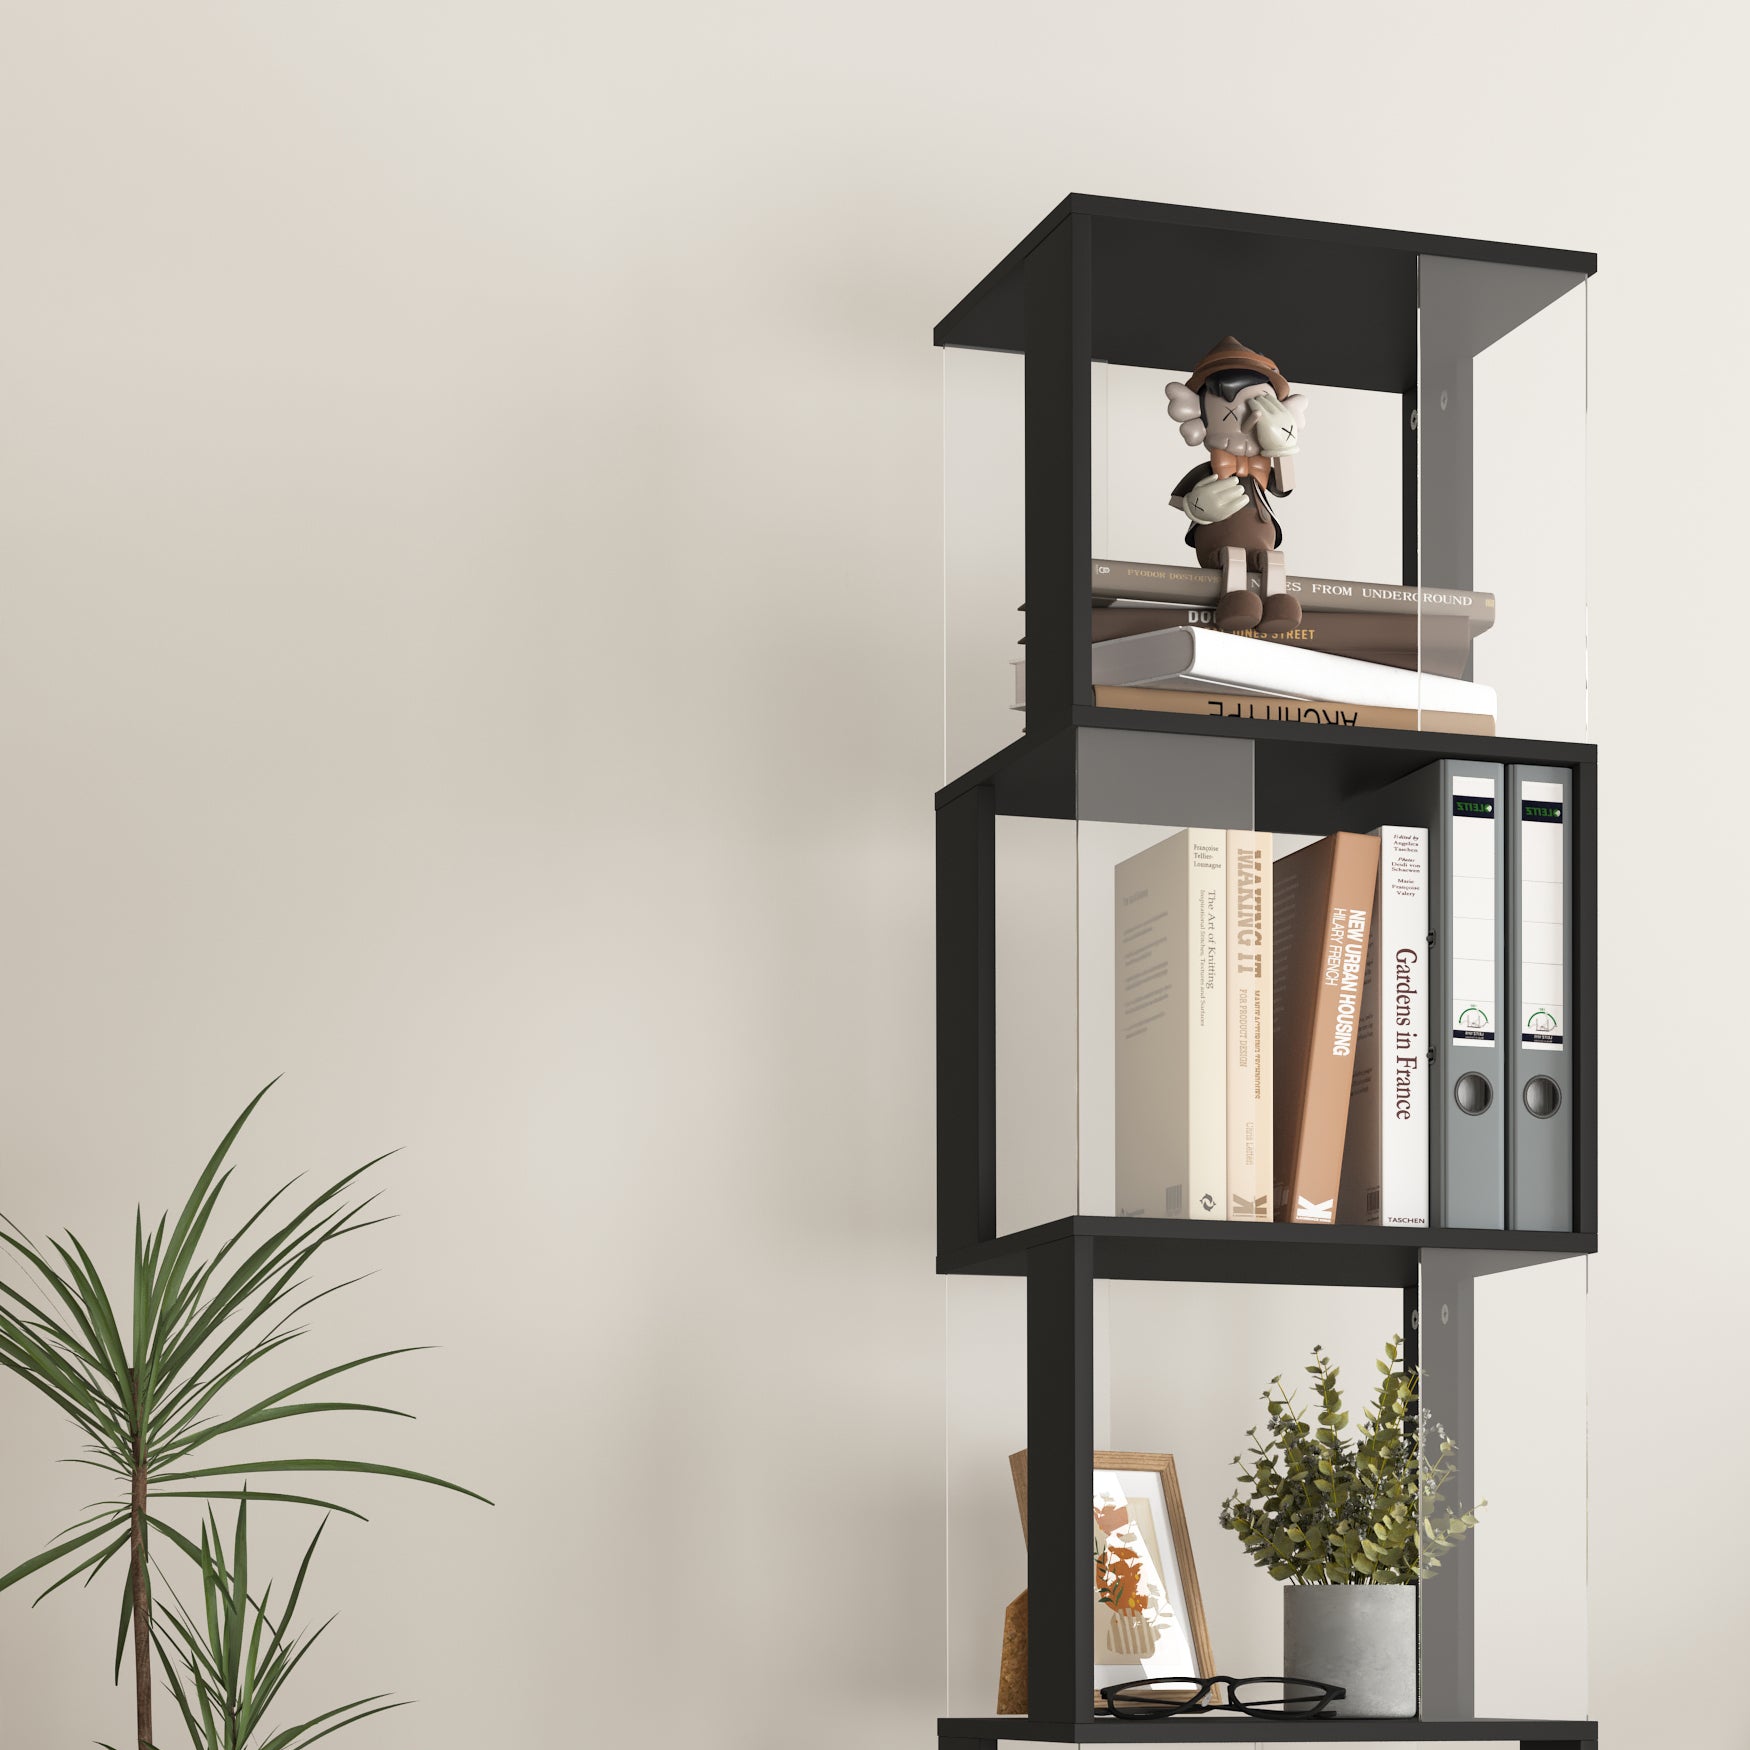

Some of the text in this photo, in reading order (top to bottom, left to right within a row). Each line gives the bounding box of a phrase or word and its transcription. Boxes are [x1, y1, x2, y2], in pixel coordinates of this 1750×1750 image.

[1127, 568, 1166, 580] FYODOR
[1251, 578, 1473, 606] NES FROM UNDERGROUND
[1205, 889, 1217, 989] The Art of Knitting
[1237, 848, 1262, 978] MAKING IT
[1325, 907, 1347, 986] HILARY FRENCH
[1332, 909, 1367, 1057] NEW URBAN HOUSING
[1239, 989, 1247, 1068] FOR PRODUCT DESIGN
[1395, 948, 1418, 1120] Gardens in France
[1387, 1216, 1425, 1224] TASCHEN
